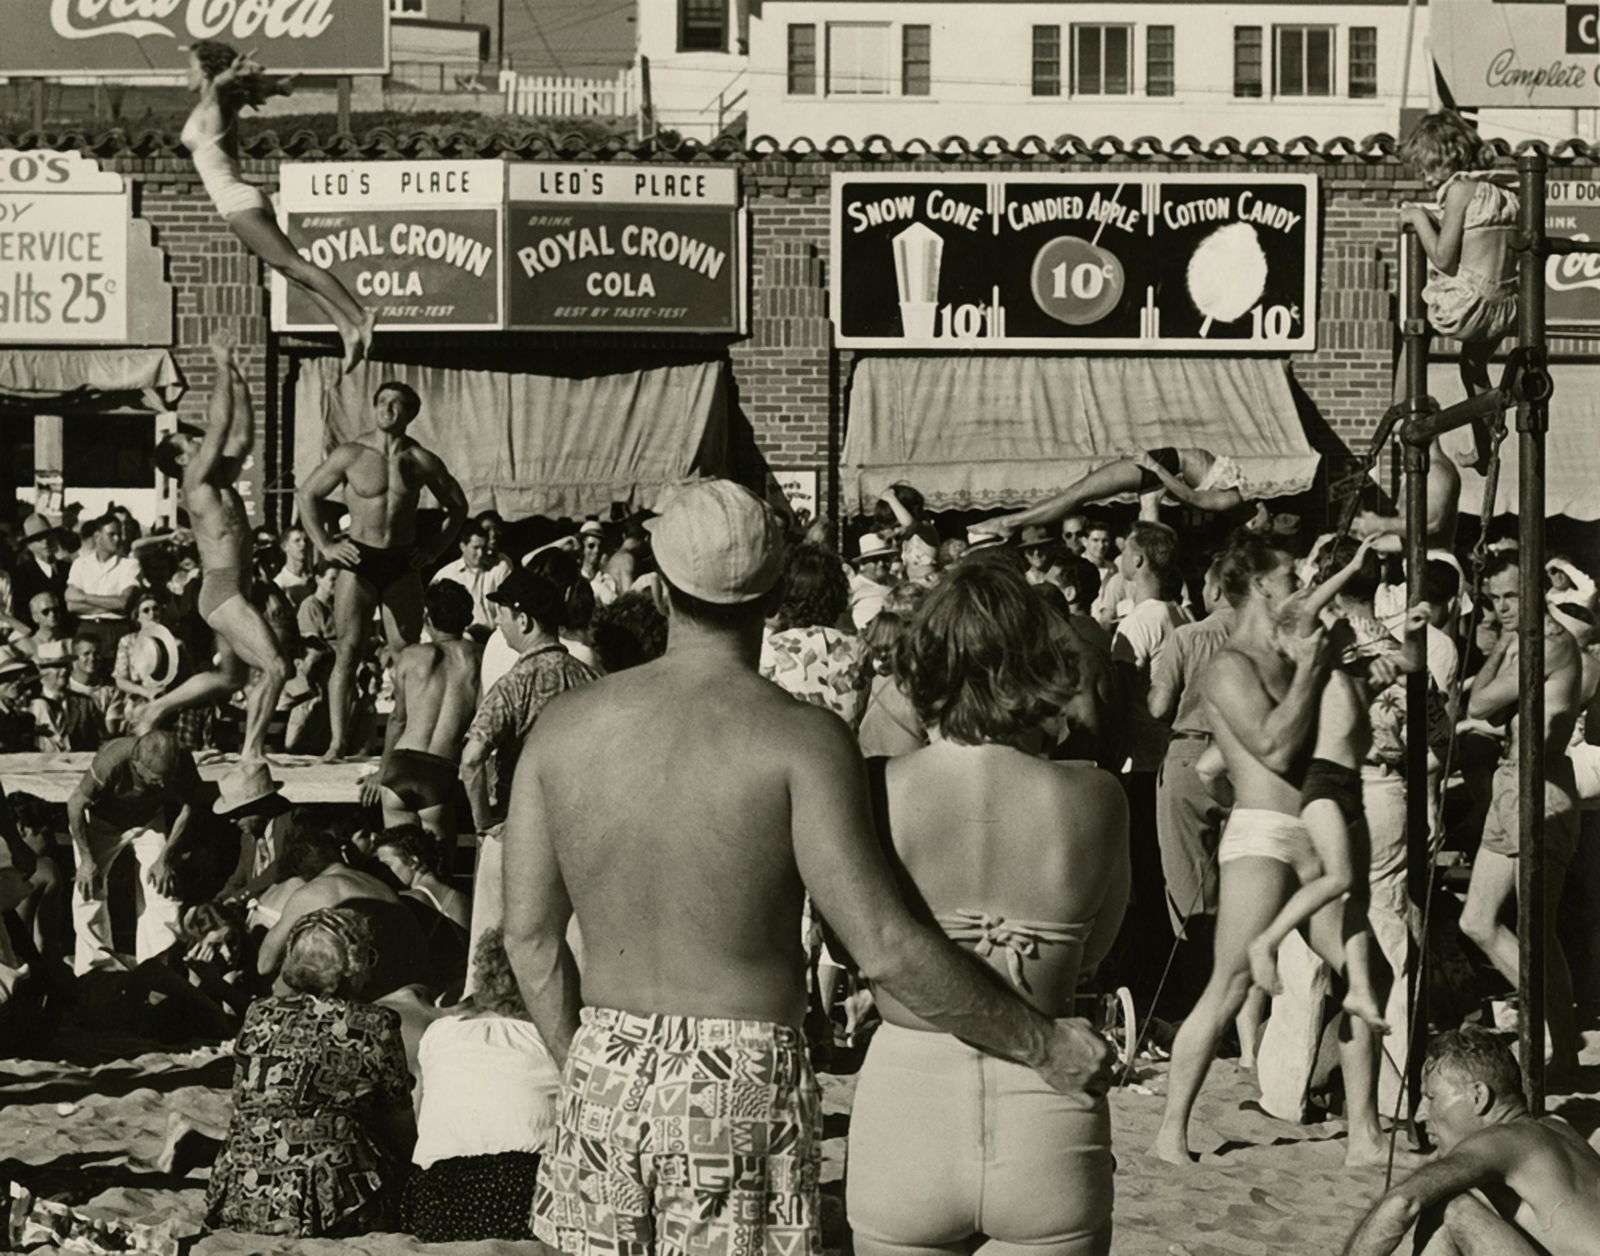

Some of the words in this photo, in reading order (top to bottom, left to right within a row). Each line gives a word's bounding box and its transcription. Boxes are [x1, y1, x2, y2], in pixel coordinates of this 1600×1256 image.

[1578, 13, 1600, 45] C
[1486, 48, 1586, 99] Complete
[0, 154, 70, 184] O'S
[312, 169, 370, 196] LEO'S
[401, 170, 471, 193] PLACE
[540, 168, 604, 196] LEO'S
[635, 172, 706, 198] PLACE
[1576, 182, 1600, 200] DO
[302, 217, 346, 229] DRINK
[528, 216, 574, 227] DRINK
[847, 195, 916, 234] SNOW
[926, 189, 984, 232] CONE
[1007, 195, 1084, 232] CANDIED
[1085, 190, 1140, 233] APPLE
[1163, 197, 1230, 230] COTTON
[1237, 190, 1301, 234] CANDY
[390, 222, 493, 278] CROWN
[517, 225, 615, 279] ROYAL
[621, 224, 726, 280] CROWN
[356, 270, 424, 297] COLA
[586, 271, 656, 298] COLA
[382, 305, 456, 318] TASTE-TEST
[553, 306, 589, 318] BEST
[590, 306, 610, 318] BY
[613, 306, 689, 319] TASTE-TEST
